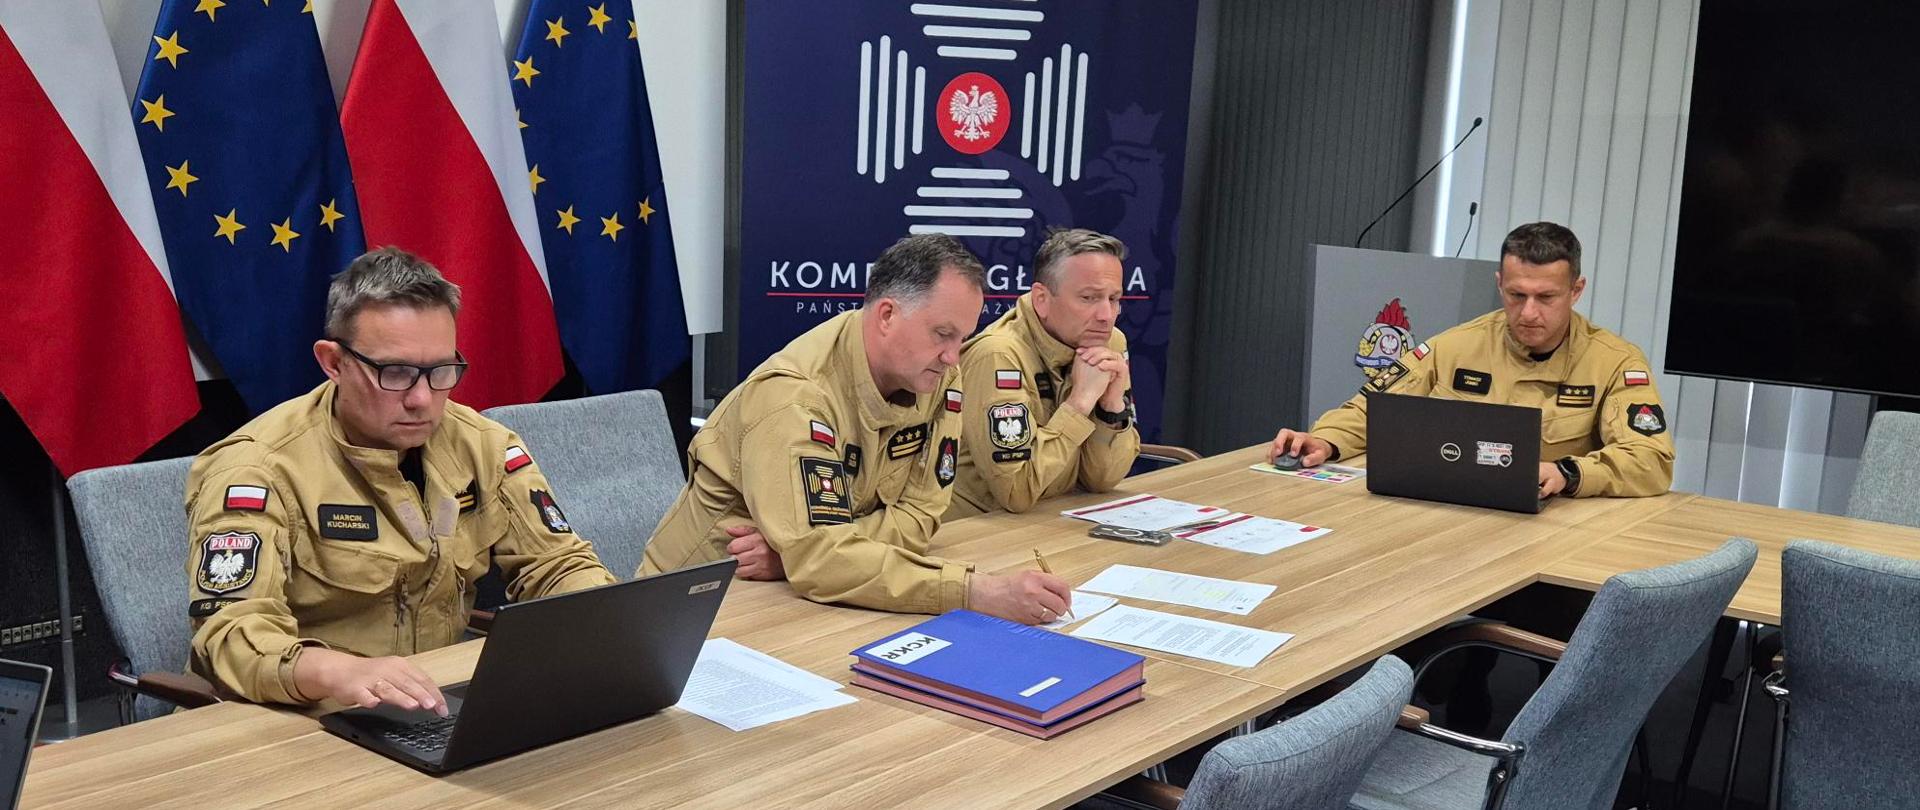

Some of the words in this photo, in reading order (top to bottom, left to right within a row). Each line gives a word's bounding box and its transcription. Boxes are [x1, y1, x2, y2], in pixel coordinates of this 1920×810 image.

[796, 300, 859, 313] PAŃST
[1443, 448, 1458, 456] DELL
[332, 513, 362, 521] MARCIN
[327, 521, 370, 529] KUCHARSKI
[211, 538, 251, 548] POLAND
[881, 636, 936, 660] KCKR
